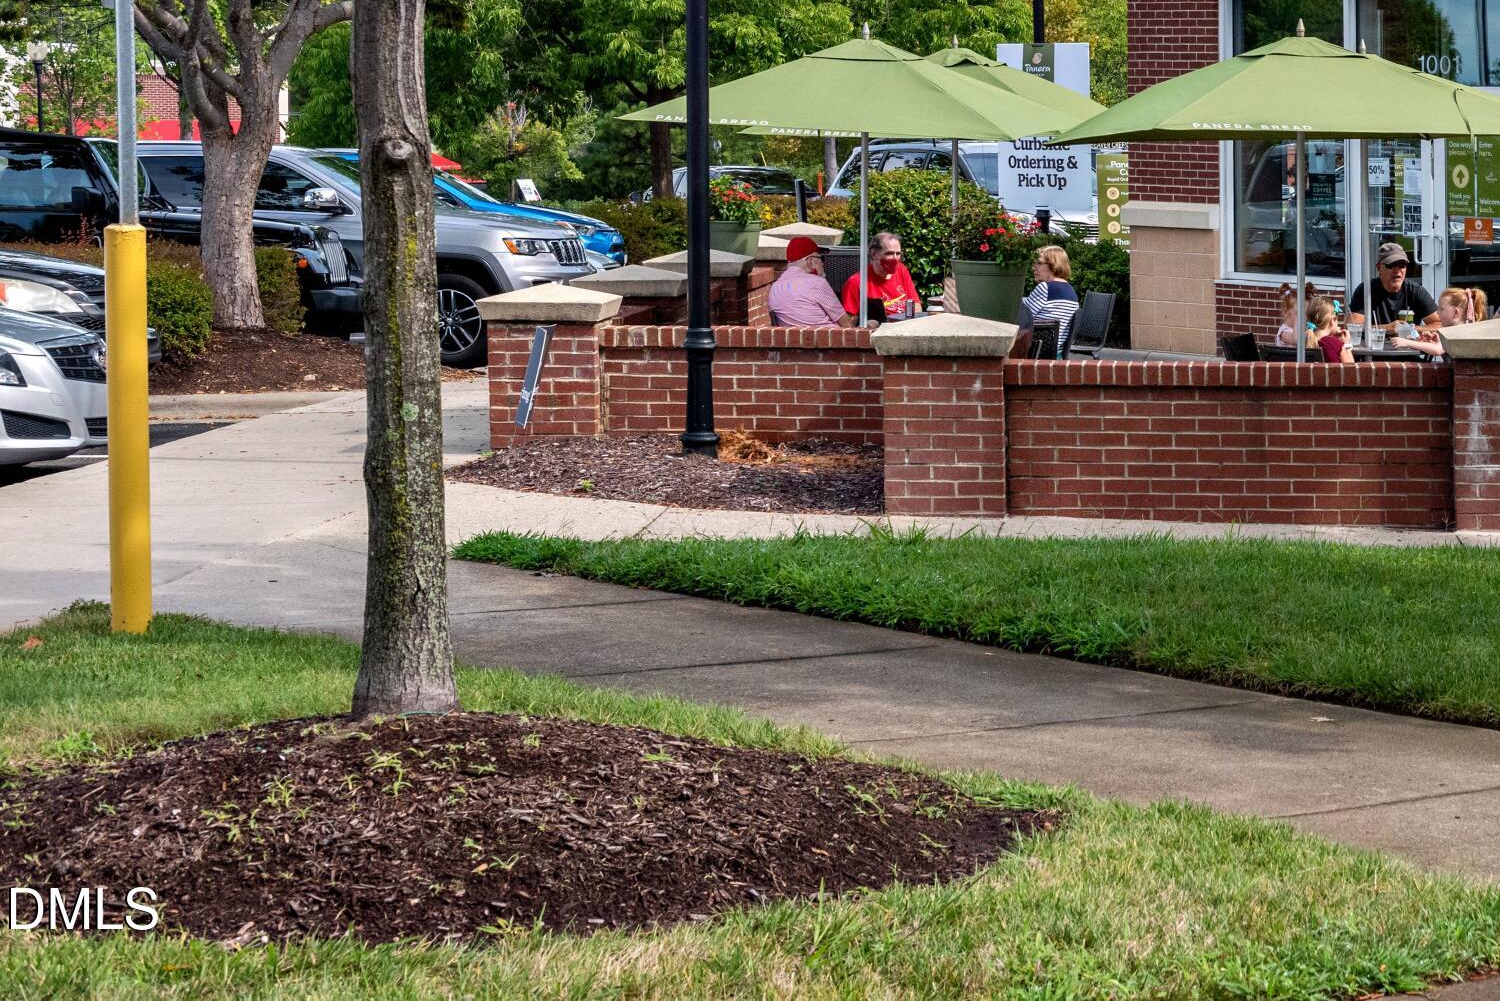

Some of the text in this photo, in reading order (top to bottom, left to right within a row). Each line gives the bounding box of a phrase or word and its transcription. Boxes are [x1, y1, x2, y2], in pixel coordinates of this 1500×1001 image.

[1418, 55, 1459, 75] 1001
[719, 118, 769, 126] BREAD
[770, 127, 819, 136] PANERA
[1008, 155, 1079, 172] Ordering &
[1368, 164, 1386, 175] 50%
[1018, 173, 1067, 190] Pick Up
